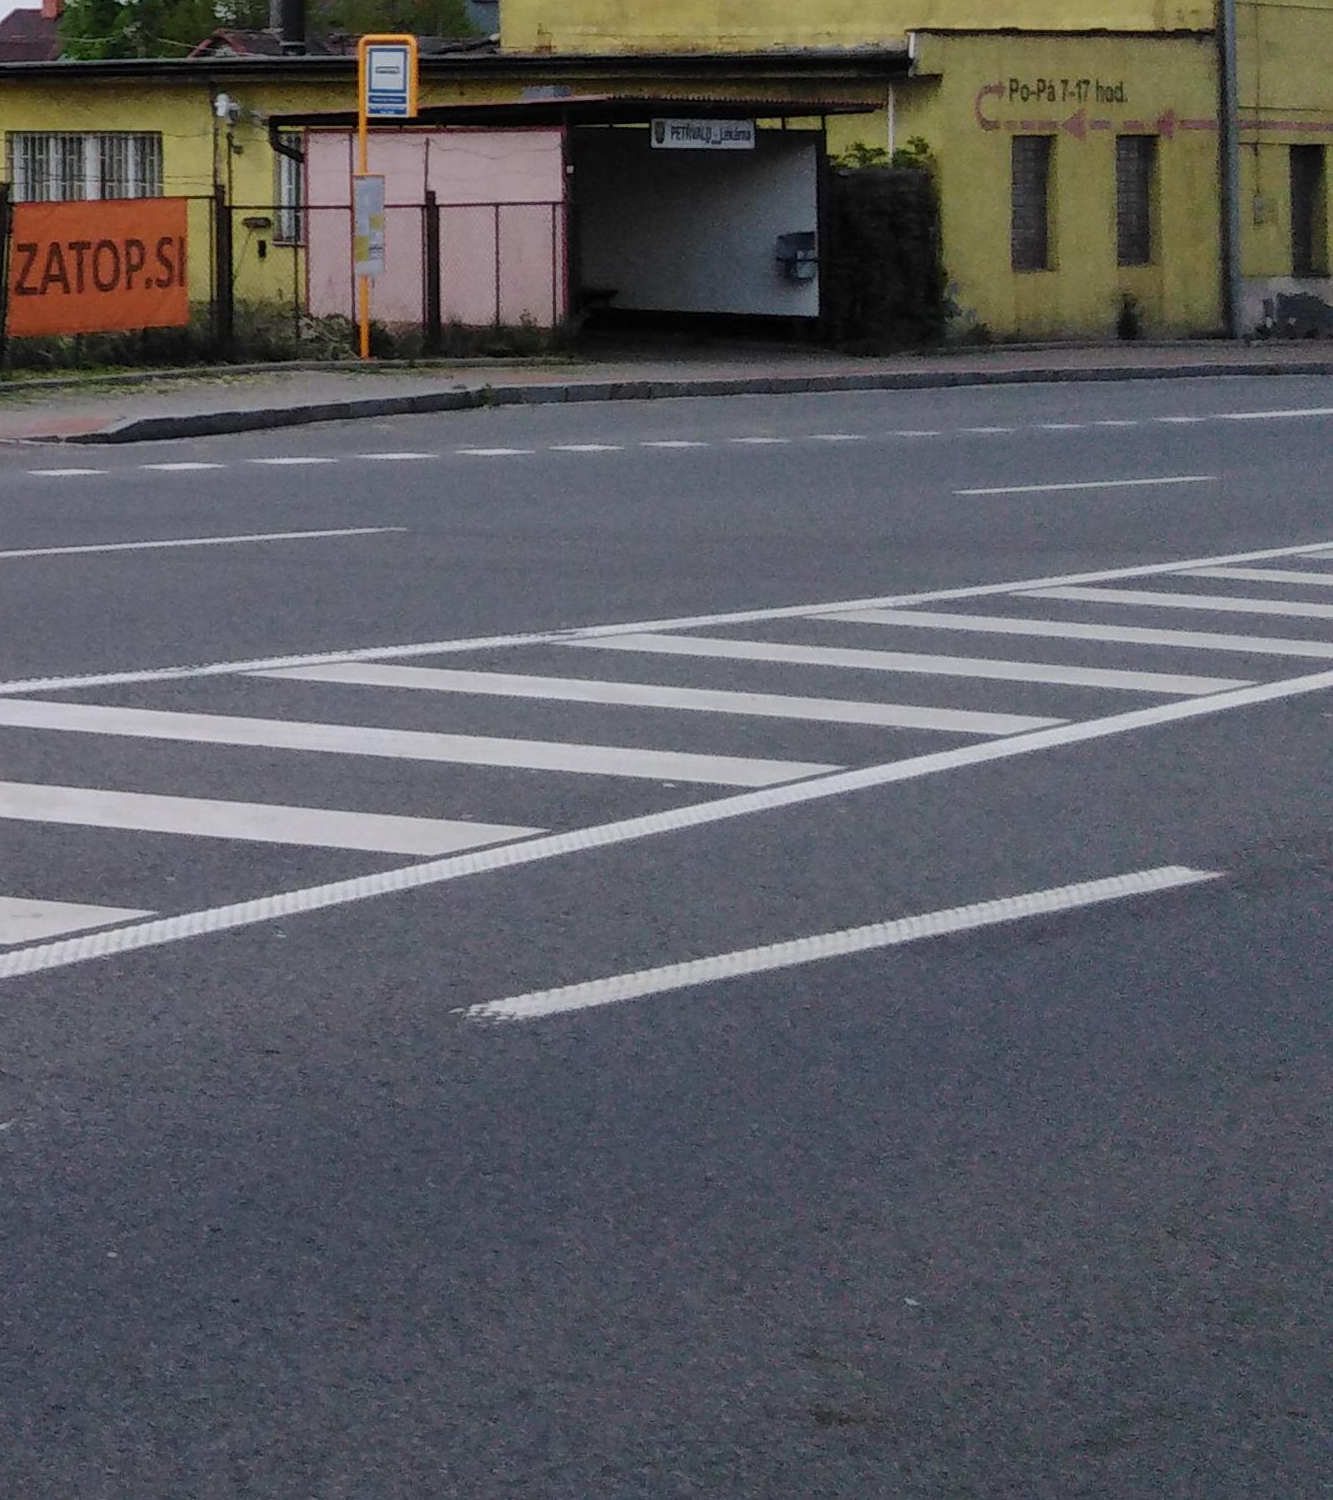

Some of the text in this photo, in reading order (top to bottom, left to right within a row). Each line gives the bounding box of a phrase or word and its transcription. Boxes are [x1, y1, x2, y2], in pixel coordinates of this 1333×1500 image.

[1008, 77, 1129, 103] Po-Pá 7-17 hod.
[13, 234, 185, 296] ZATOP.SI
